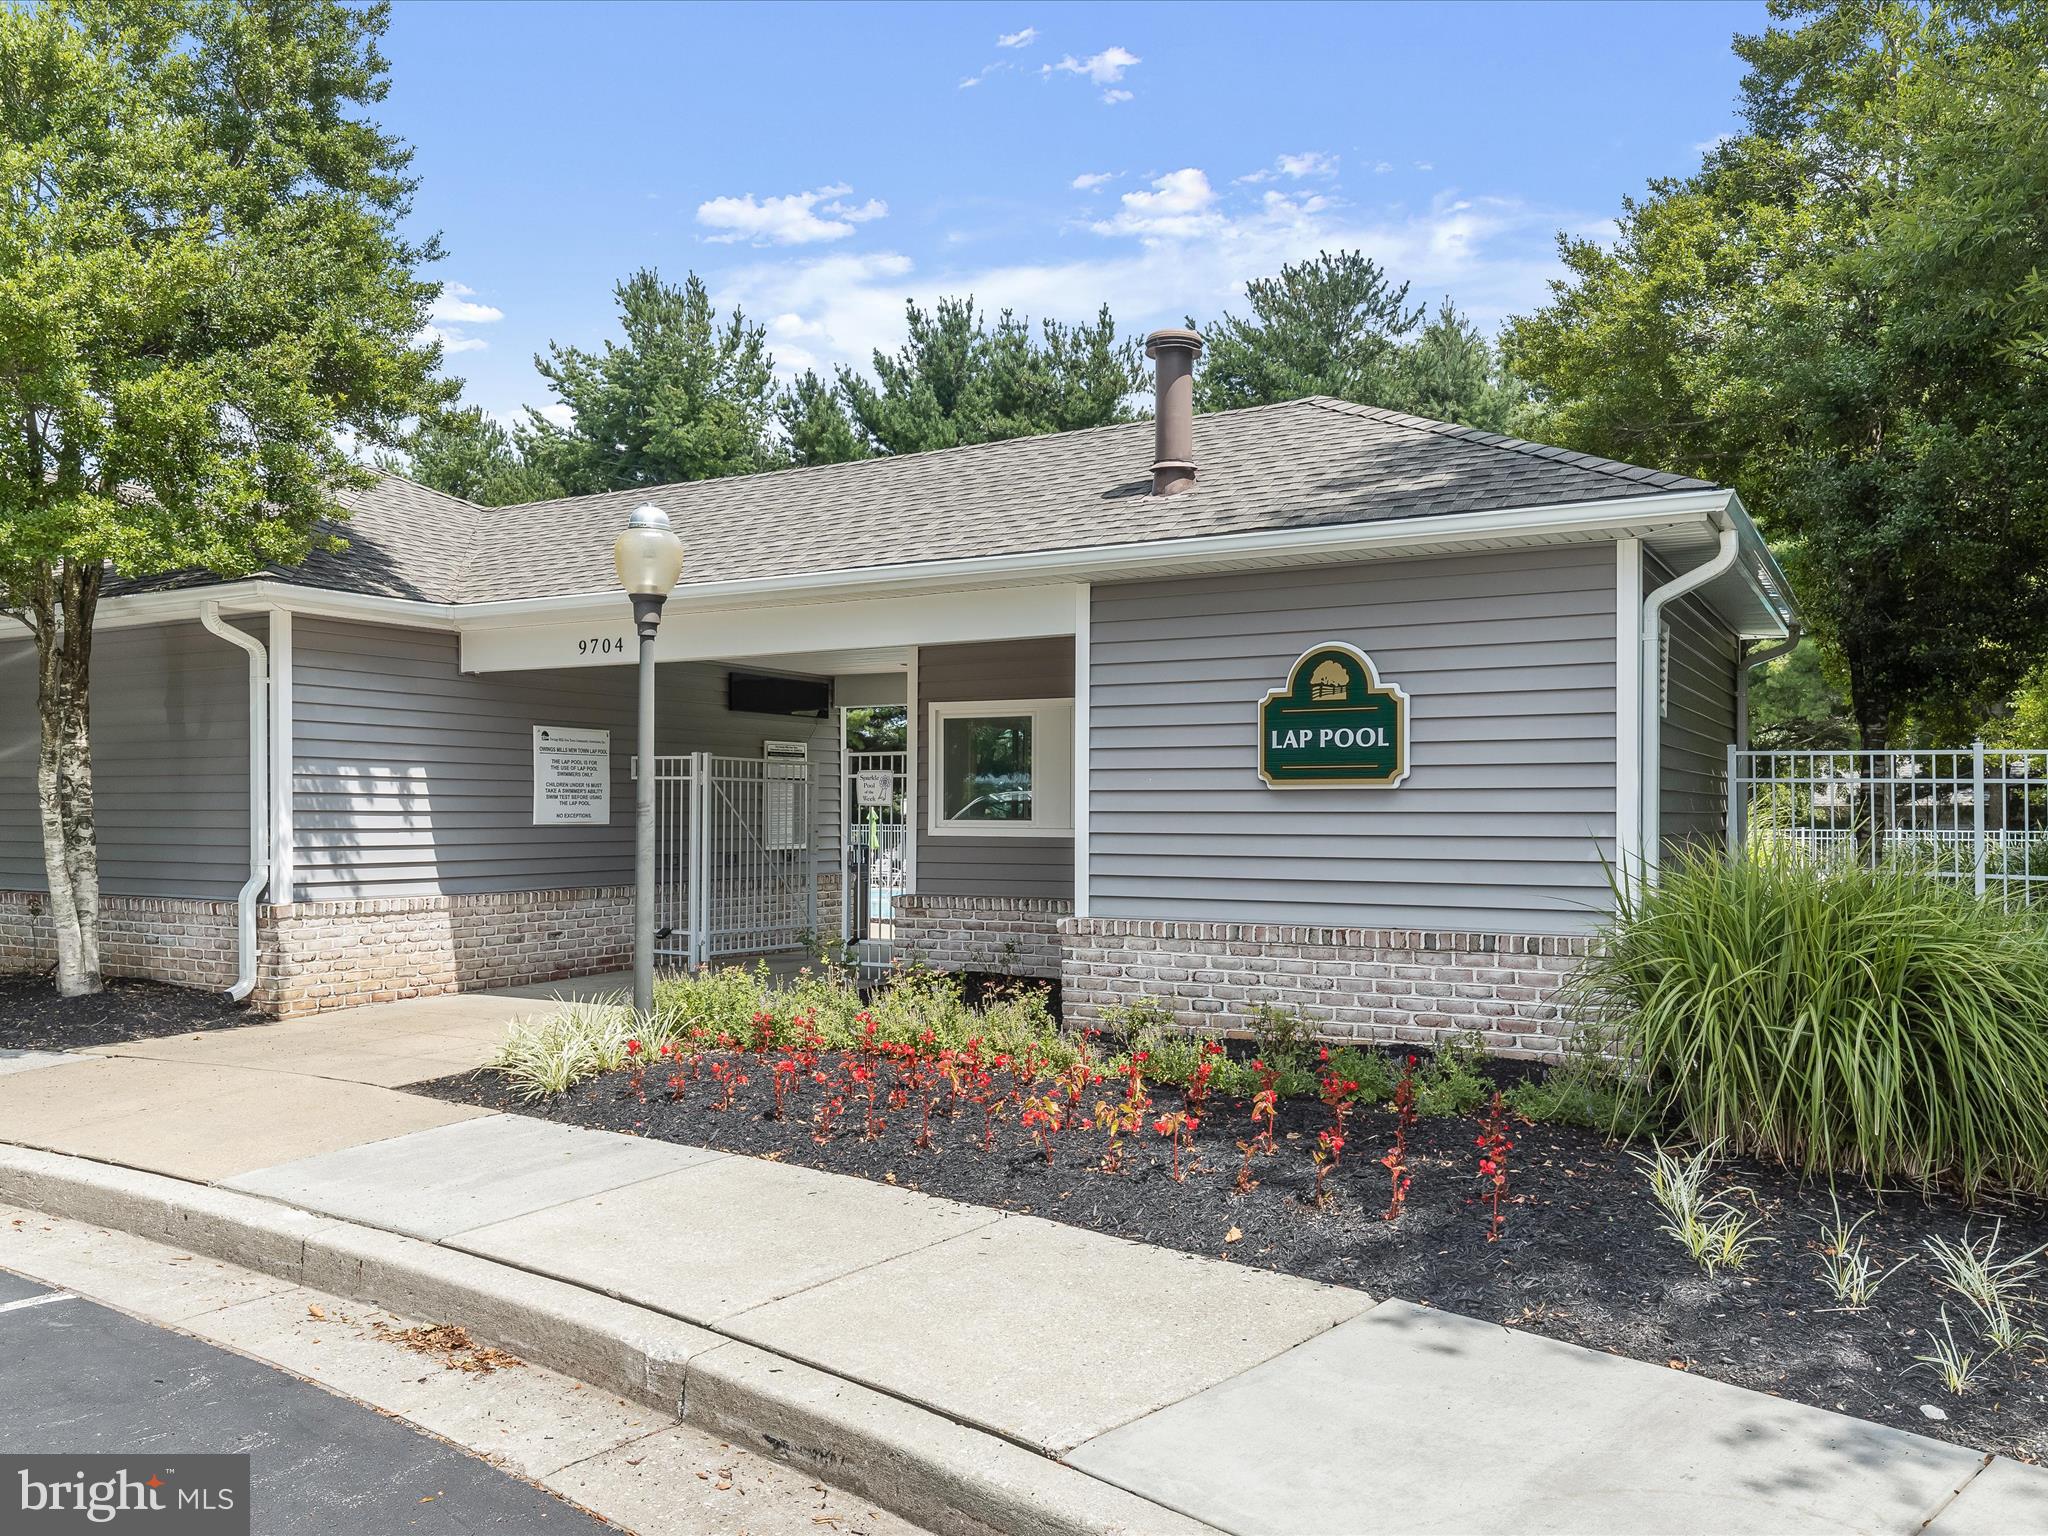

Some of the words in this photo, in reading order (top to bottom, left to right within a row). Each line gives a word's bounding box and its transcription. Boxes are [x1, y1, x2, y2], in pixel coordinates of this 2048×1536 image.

[579, 637, 623, 654] 9704
[1271, 729, 1312, 748] LAP
[1320, 727, 1389, 748] POOL
